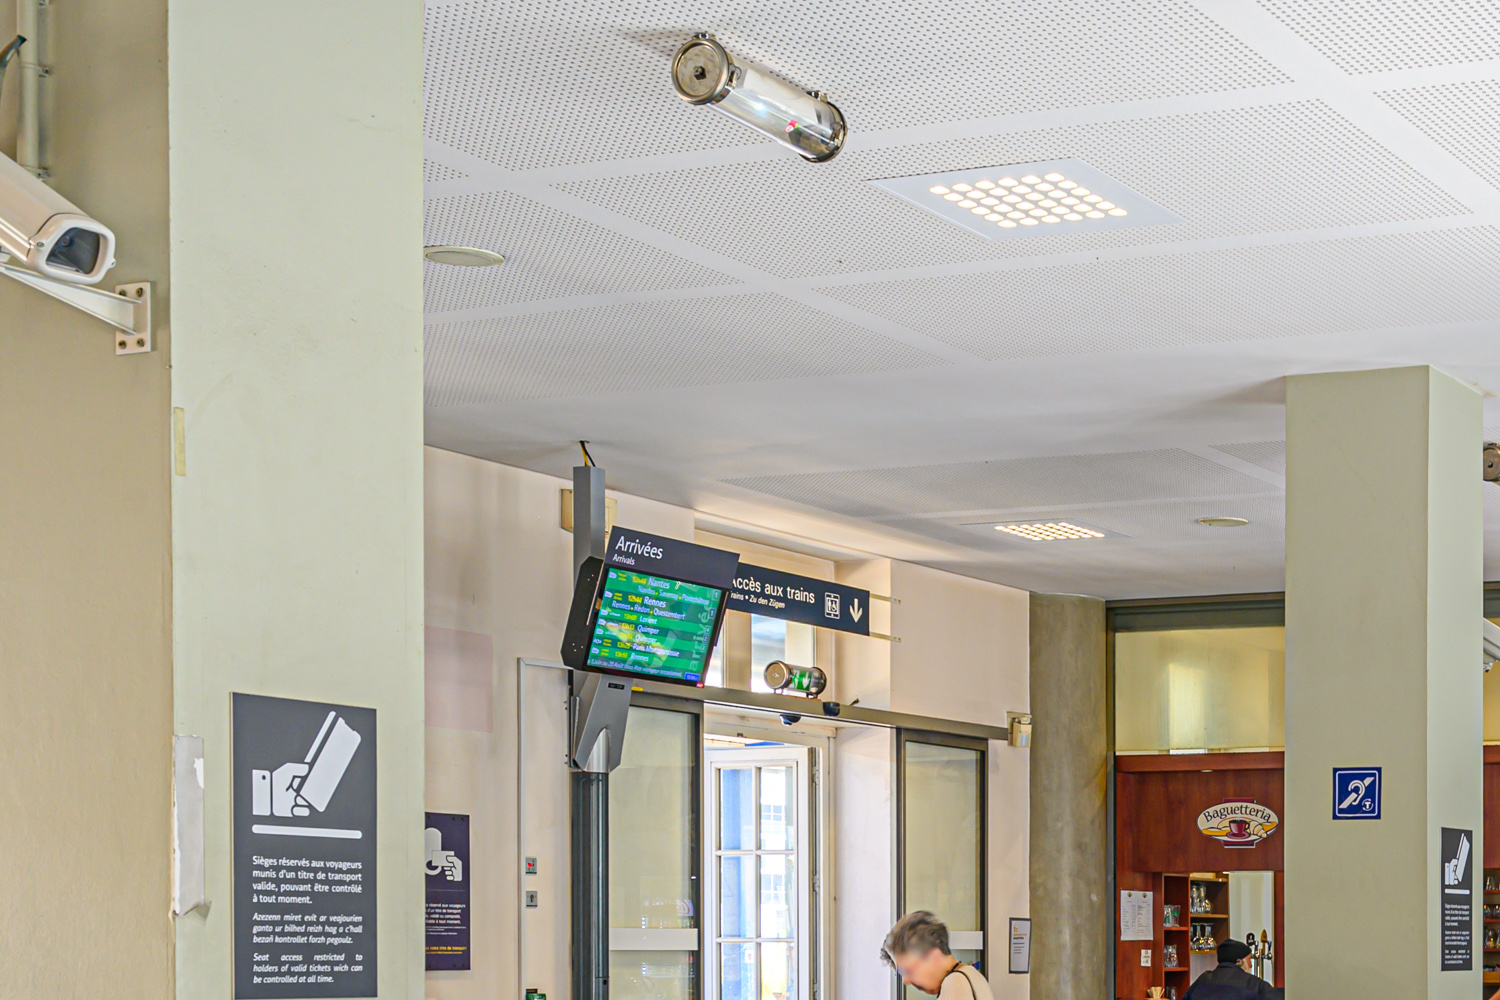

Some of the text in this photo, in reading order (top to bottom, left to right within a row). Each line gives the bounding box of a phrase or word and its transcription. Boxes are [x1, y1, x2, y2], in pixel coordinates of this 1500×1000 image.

[615, 536, 663, 560] Arrivées
[612, 554, 635, 566] Arrivals
[648, 577, 670, 590] Nantes
[764, 583, 784, 597] aux
[786, 586, 815, 604] trains
[612, 600, 630, 610] Rennes
[634, 603, 650, 613] Redon
[644, 596, 666, 608] Rennes
[749, 594, 758, 603] Zu
[758, 597, 768, 605] den
[768, 598, 786, 609] Zügen
[640, 616, 658, 624] Lorient
[638, 625, 659, 634] Quimper
[631, 652, 649, 661] Rennes
[1203, 804, 1271, 822] Baguetteria
[252, 856, 277, 867] Sièges
[279, 857, 310, 867] réservés
[326, 861, 362, 870] voyageurs
[252, 869, 362, 882] munis d'un titre de transport
[252, 881, 362, 893] valide, pouvant être contrôlé
[252, 894, 257, 902] à
[259, 894, 276, 903] tout
[252, 912, 281, 921] Azezenn
[252, 925, 273, 934] ganto
[284, 924, 305, 932] bilhed
[324, 925, 337, 934] hag
[253, 953, 269, 961] Seat
[253, 964, 278, 972] holders
[281, 964, 289, 972] of
